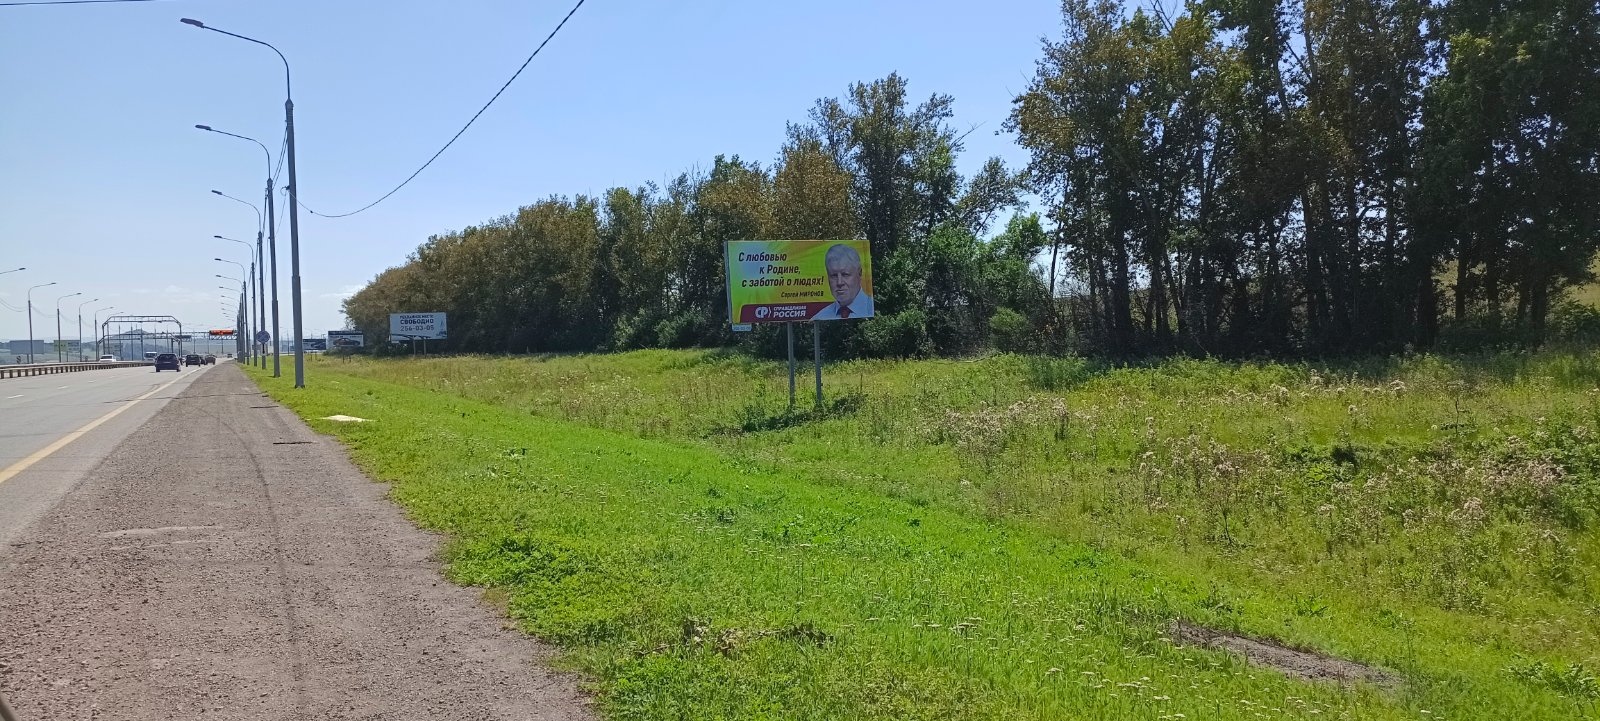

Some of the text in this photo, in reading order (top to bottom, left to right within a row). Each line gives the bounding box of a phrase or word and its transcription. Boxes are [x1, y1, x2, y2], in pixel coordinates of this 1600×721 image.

[739, 252, 787, 262] С любовью
[768, 264, 801, 275] Родине,
[750, 277, 784, 287] заботой
[794, 276, 824, 286] людях!
